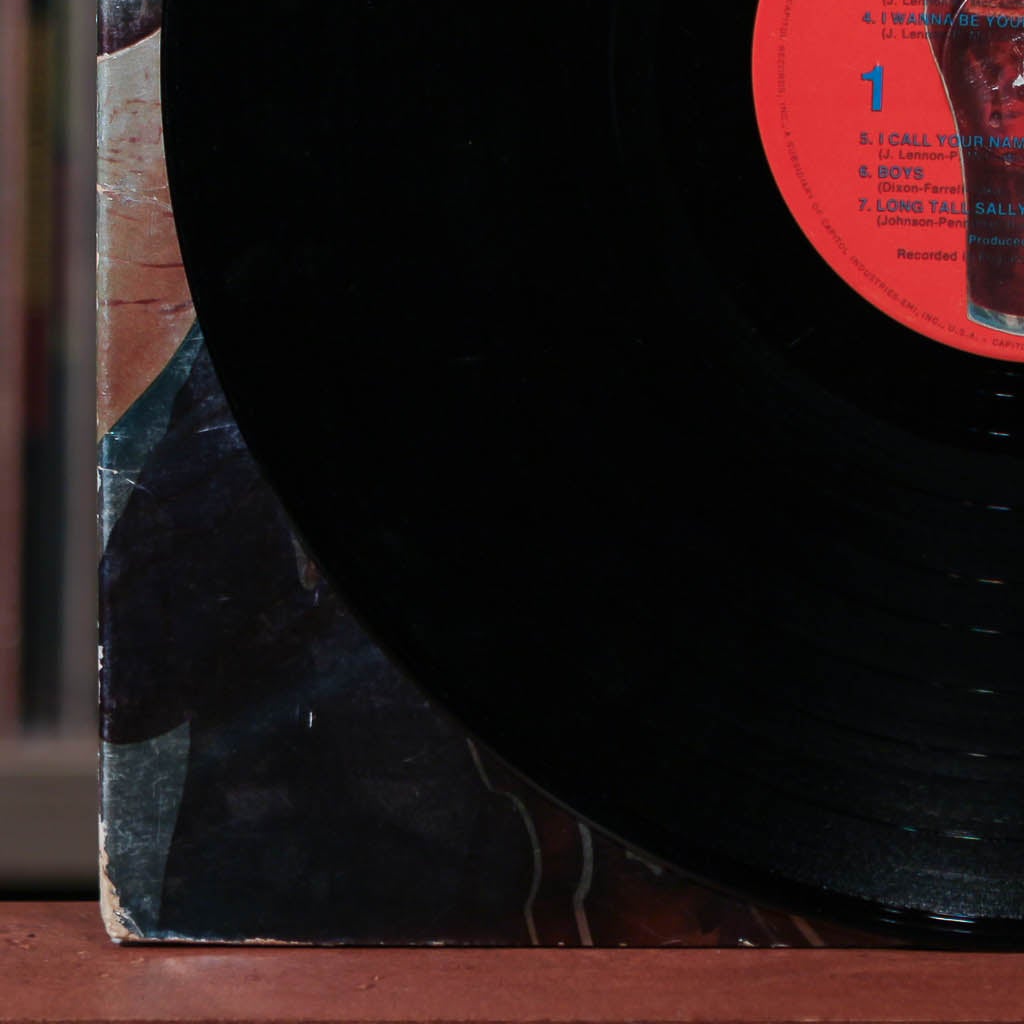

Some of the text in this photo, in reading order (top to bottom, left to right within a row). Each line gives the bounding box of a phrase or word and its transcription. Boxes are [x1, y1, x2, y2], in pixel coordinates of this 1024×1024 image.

[862, 12, 876, 25] 4.
[891, 13, 953, 27] WANNA
[959, 14, 983, 27] BE
[861, 64, 885, 112] 1
[859, 132, 873, 146] 5.
[888, 132, 932, 147] CALL
[937, 133, 984, 149] YOUR
[858, 166, 925, 180] 6. BOYS
[858, 199, 872, 212] 7.
[876, 199, 925, 214] LONG
[929, 200, 969, 216] TALL
[819, 216, 852, 257] CAPITOL
[897, 248, 958, 262] Recorded
